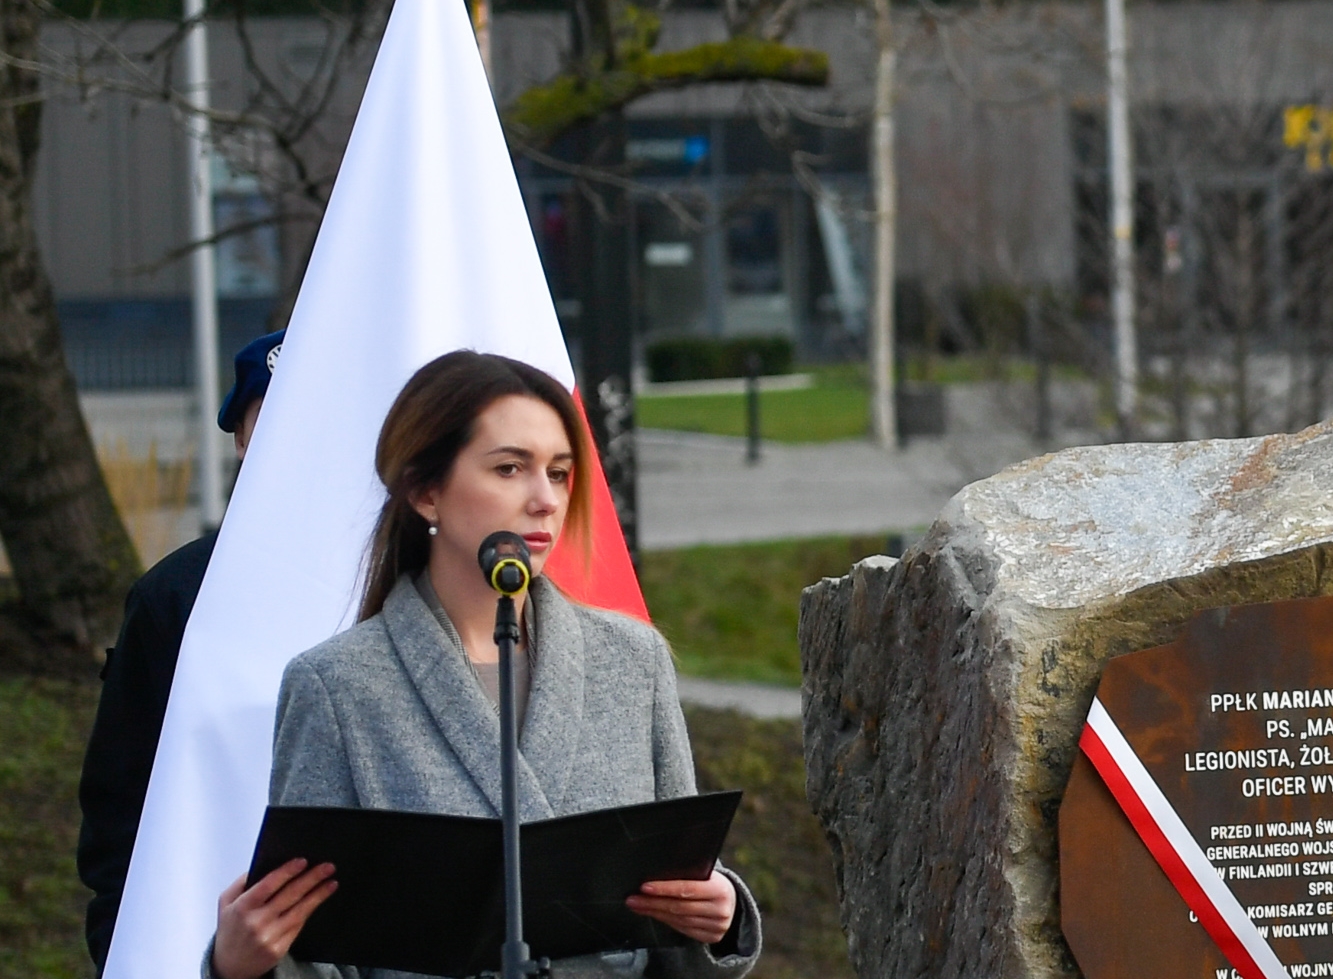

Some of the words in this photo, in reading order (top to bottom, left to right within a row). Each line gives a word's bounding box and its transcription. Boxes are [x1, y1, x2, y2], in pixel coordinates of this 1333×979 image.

[1211, 693, 1257, 712] PPŁK
[1267, 720, 1294, 738] PS.
[1185, 749, 1294, 771] LEGIONISTA,
[1242, 777, 1305, 797] OFICER
[1211, 825, 1251, 839] PRZED
[1255, 824, 1263, 837] II
[1266, 822, 1312, 837] WOJNĄ
[1206, 843, 1298, 860] GENERALNEGO
[1229, 863, 1291, 879] FINLANDII
[1295, 863, 1299, 876] I
[1247, 901, 1313, 919] KOMISARZ
[1257, 926, 1268, 938] W
[1272, 923, 1328, 938] WOLNYM
